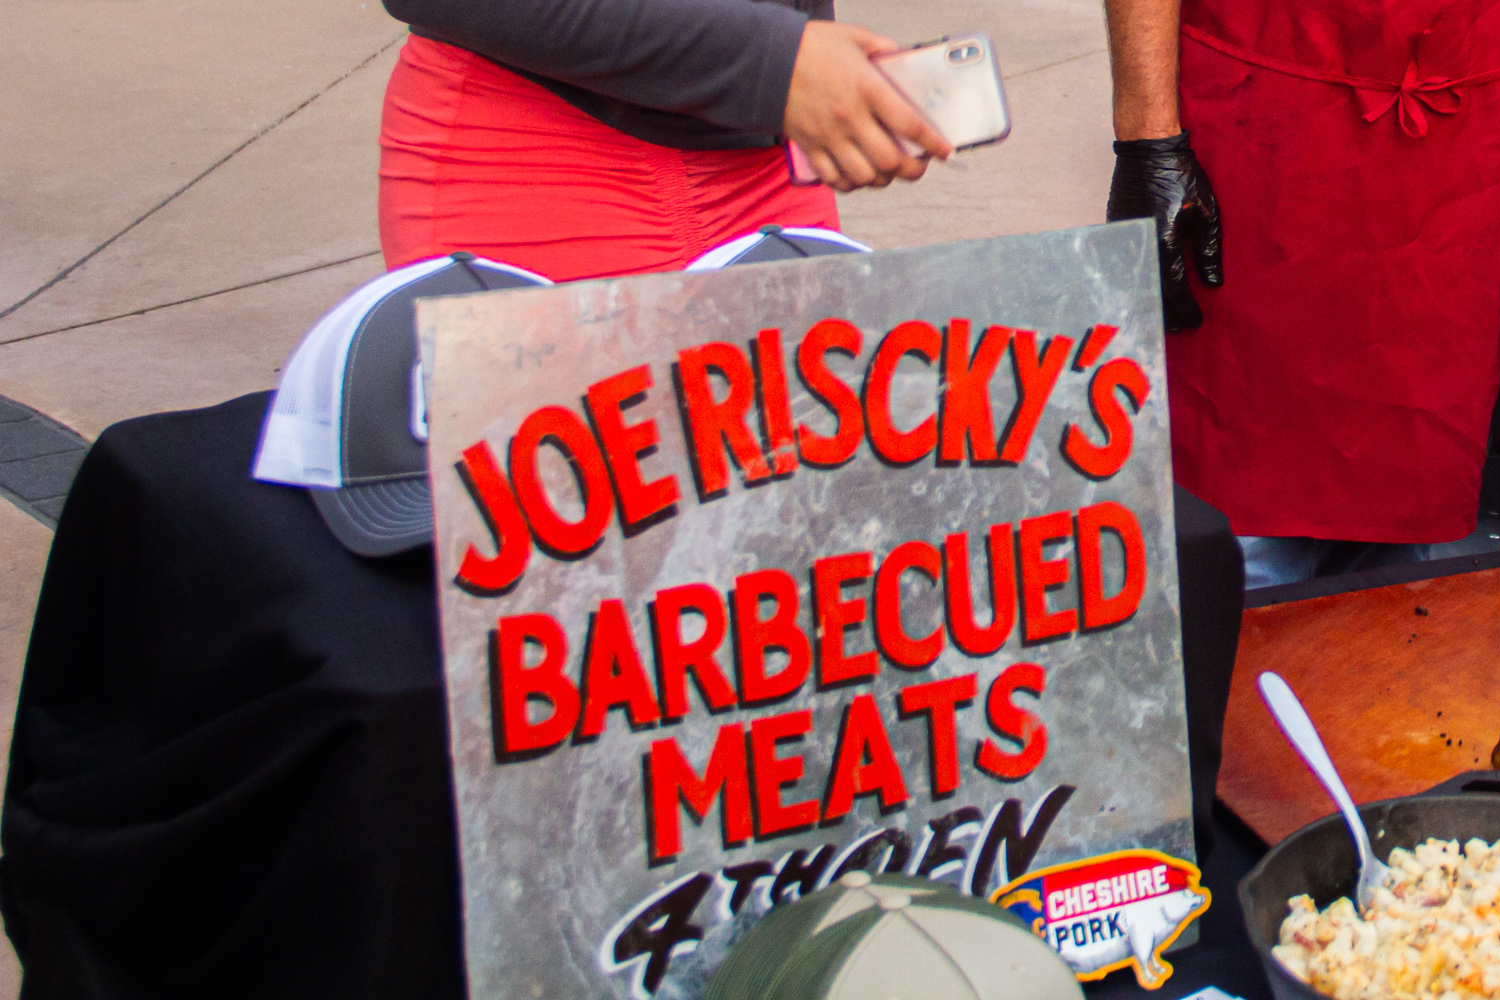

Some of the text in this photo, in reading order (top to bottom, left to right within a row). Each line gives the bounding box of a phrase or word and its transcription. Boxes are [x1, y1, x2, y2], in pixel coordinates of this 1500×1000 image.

[454, 317, 1151, 594] JOE RISCKY'S
[490, 501, 1148, 764] BARBECUED
[647, 661, 1048, 866] MEATS
[1047, 865, 1170, 920] CHESHIRE
[1055, 911, 1126, 952] PORK
